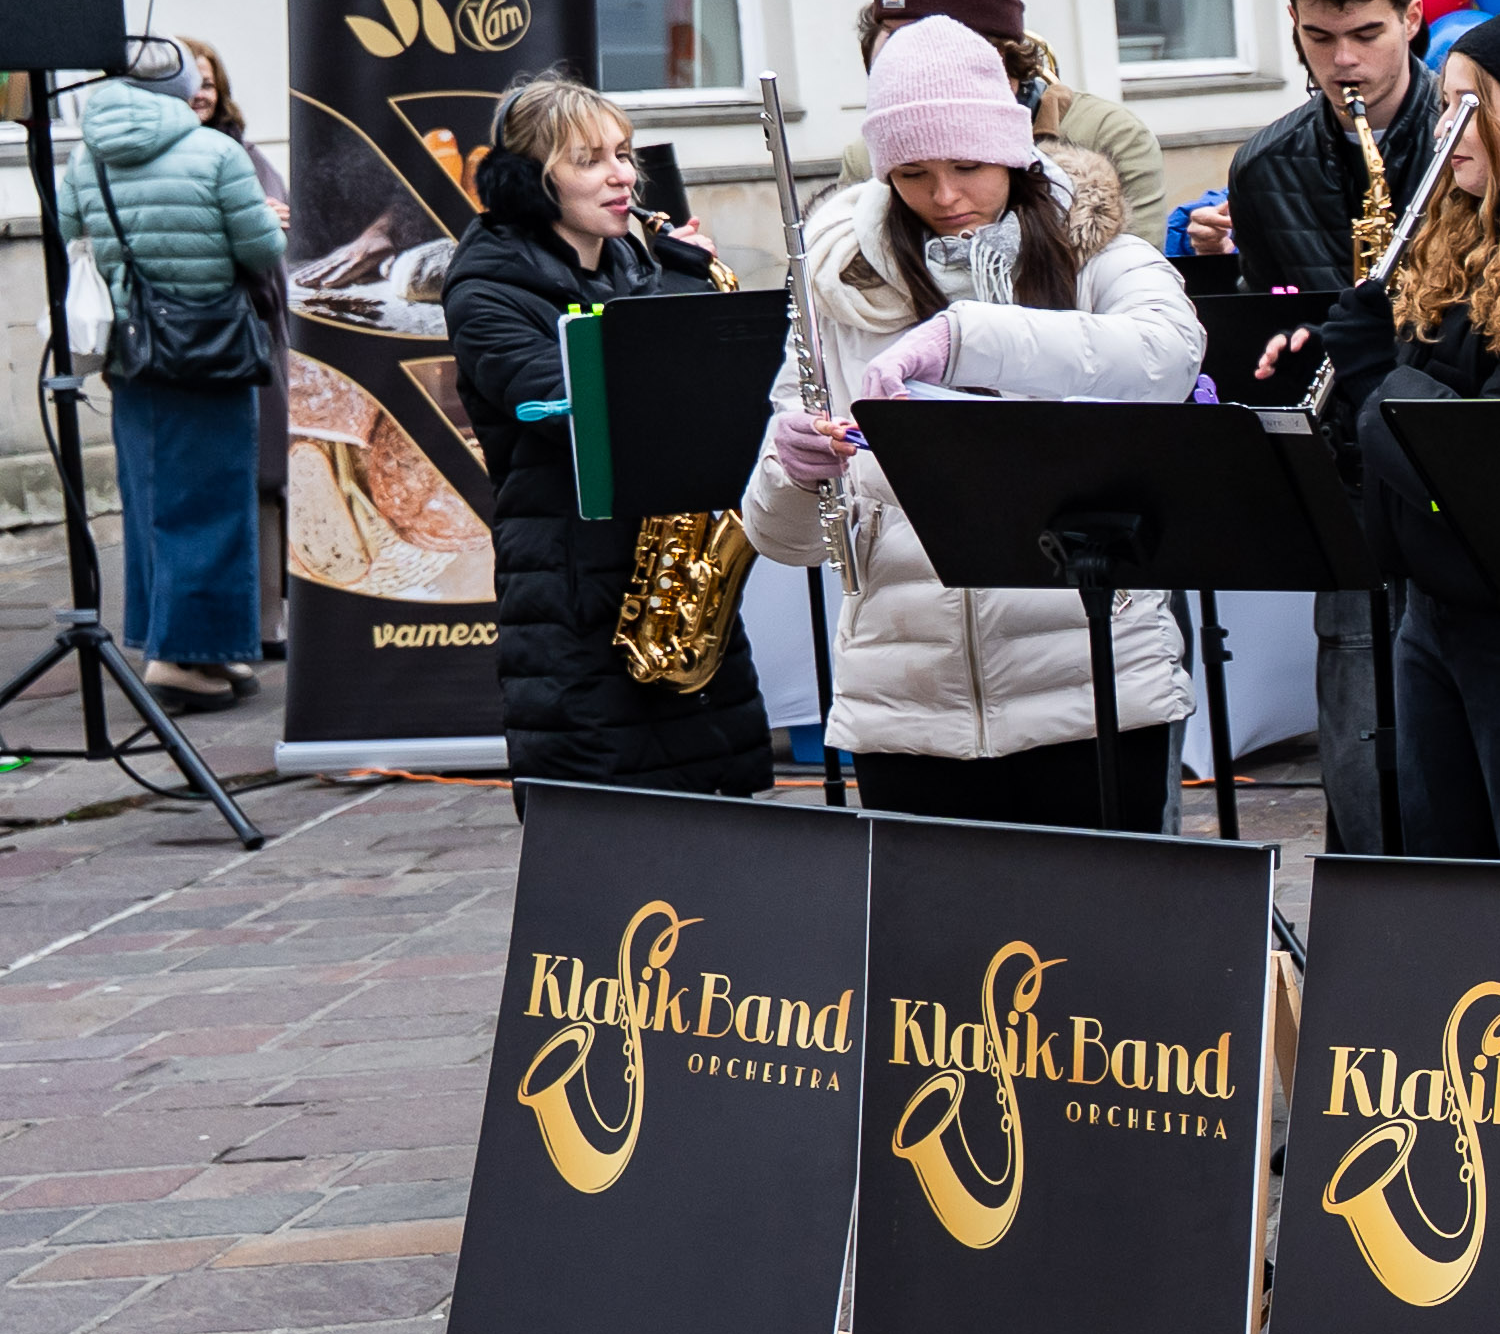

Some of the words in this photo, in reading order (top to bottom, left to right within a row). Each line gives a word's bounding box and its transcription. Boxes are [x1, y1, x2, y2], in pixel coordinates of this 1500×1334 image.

[373, 621, 499, 649] vamex
[693, 972, 854, 1054] Band
[687, 1053, 840, 1092] ORCHESTRA
[1067, 1015, 1236, 1100] Band
[1065, 1101, 1228, 1140] ORCHESTRA
